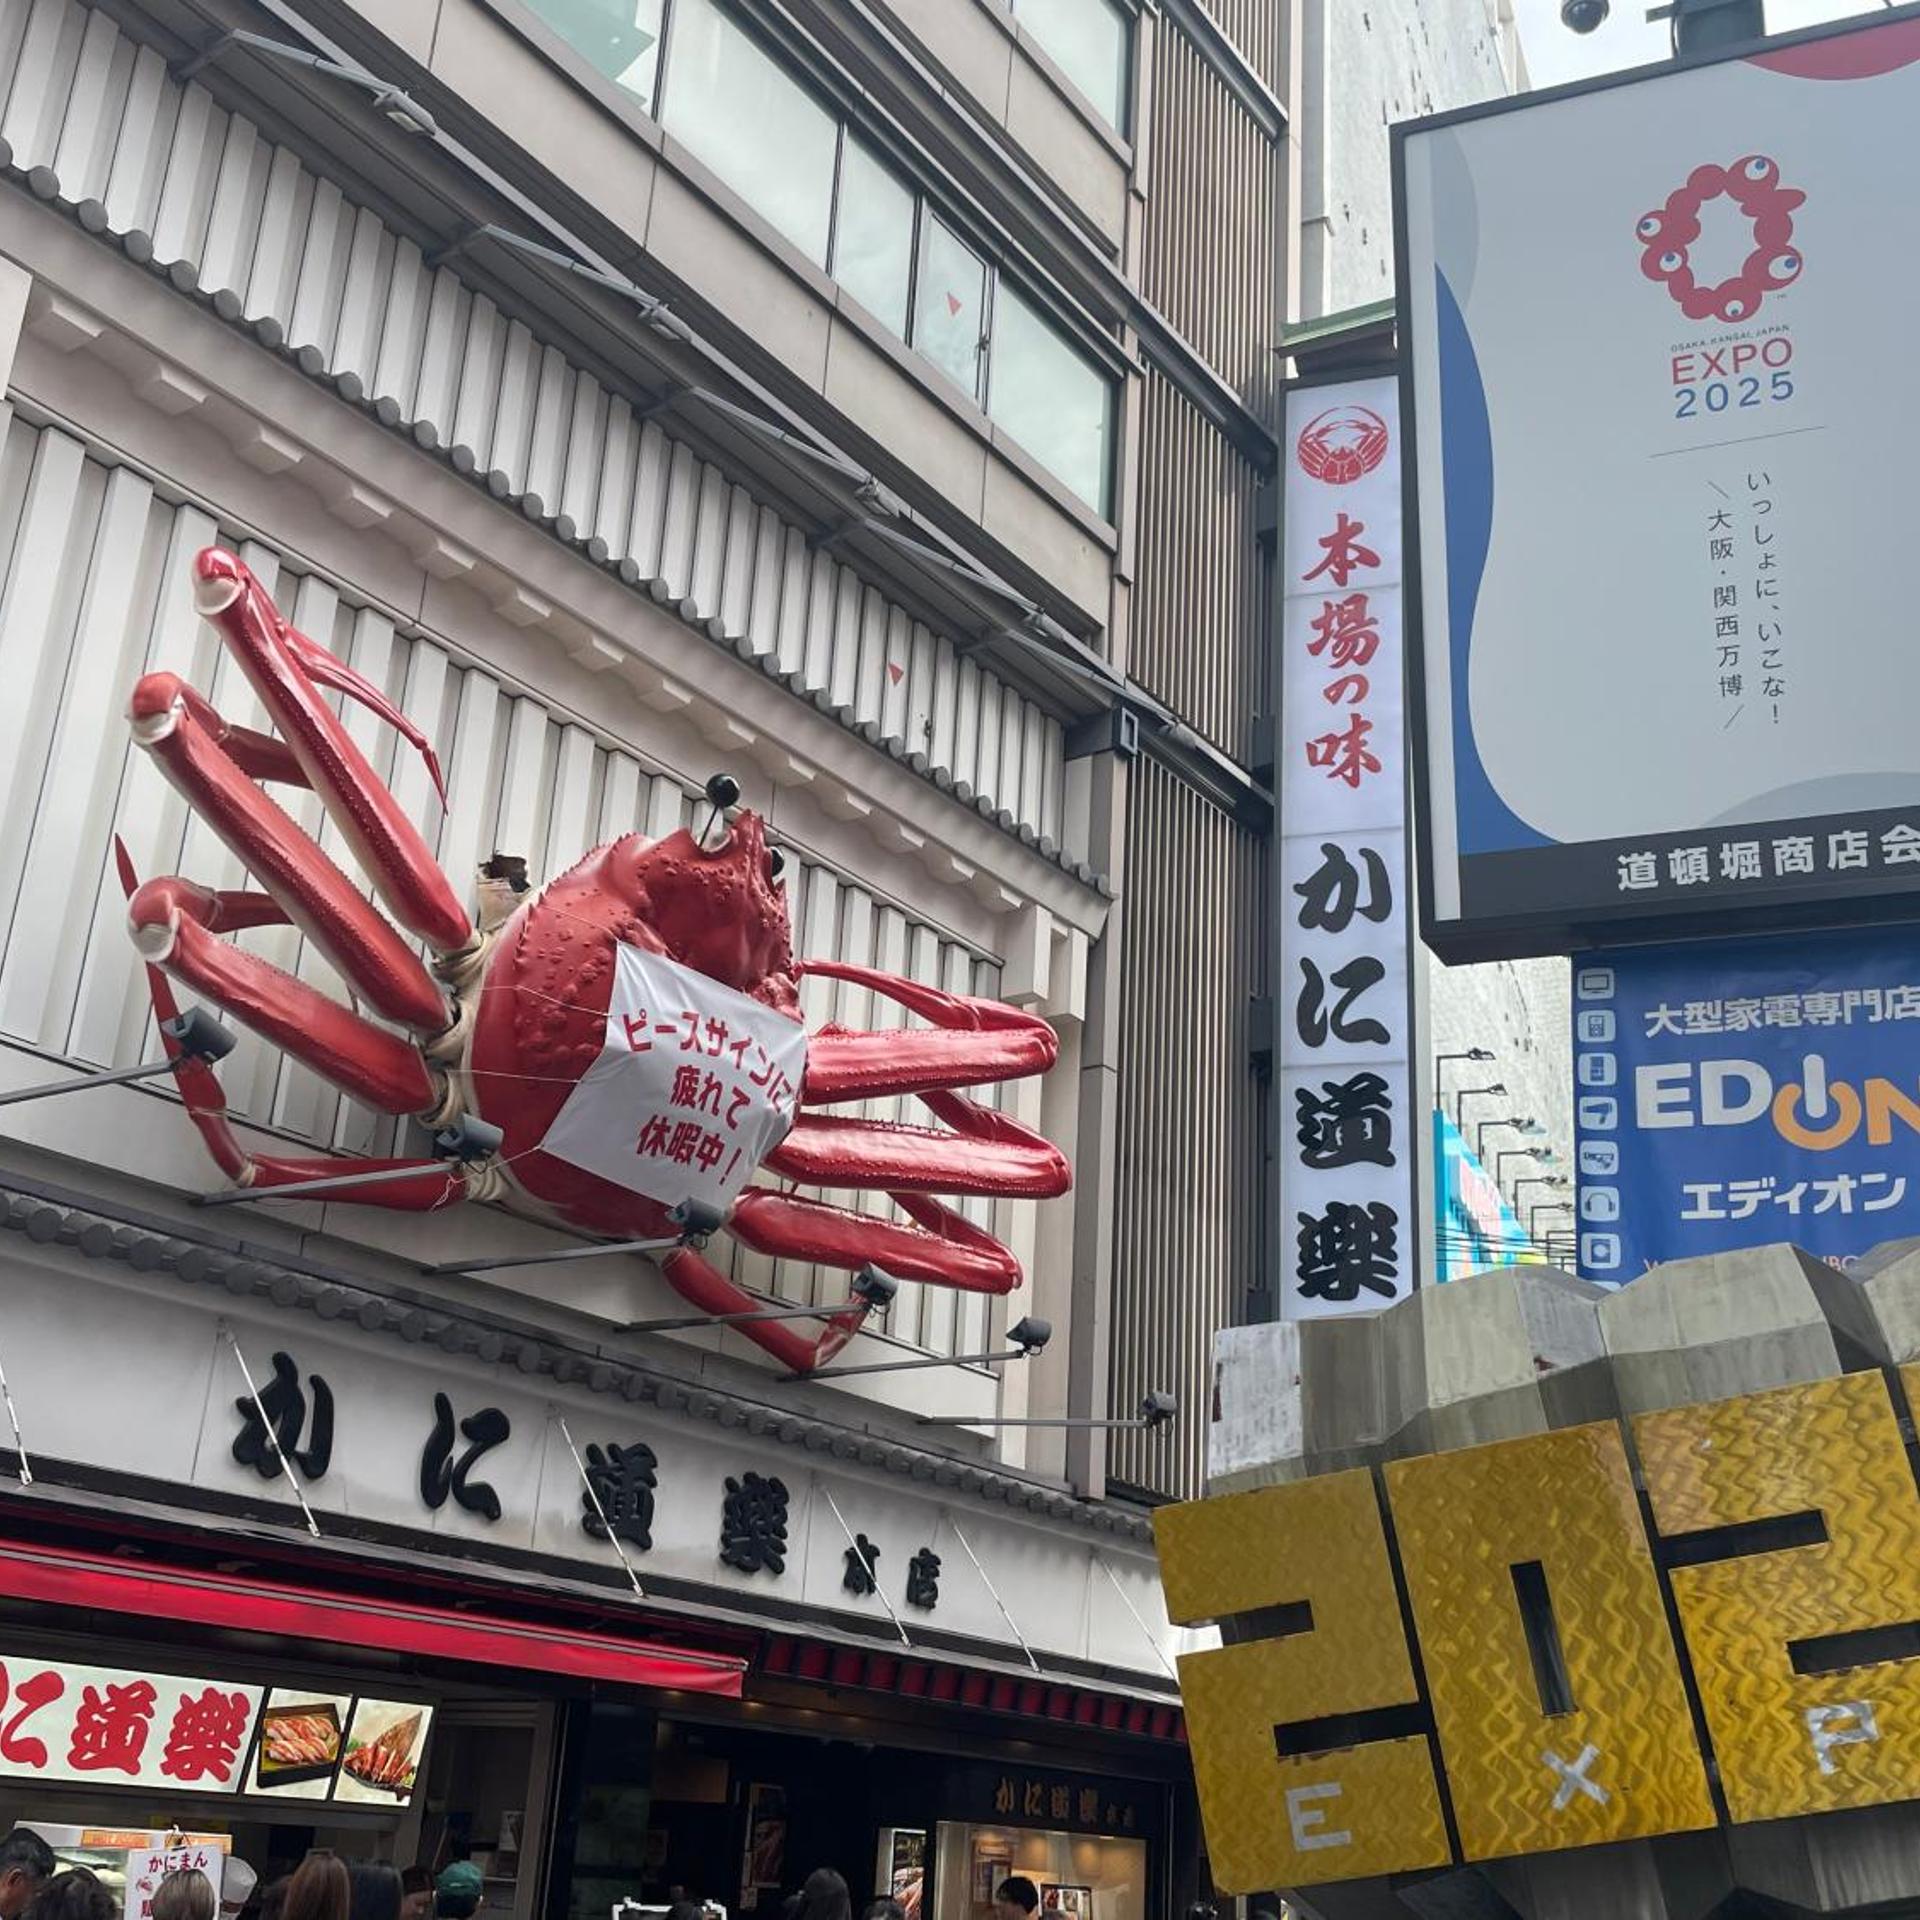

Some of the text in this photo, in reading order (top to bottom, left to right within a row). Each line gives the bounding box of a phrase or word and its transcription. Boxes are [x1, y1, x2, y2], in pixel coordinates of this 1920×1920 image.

[1756, 324, 1790, 338] JAPAN
[1671, 337, 1793, 385] EXPO
[1674, 371, 1794, 419] 2025
[1302, 513, 1382, 789] 本場の味
[1617, 824, 1920, 891] 道頓堀商店会
[1644, 985, 1920, 1039] 大型家電専門店
[622, 1008, 791, 1114] ピースサインに
[669, 1065, 750, 1130] 疲れて
[636, 1114, 742, 1185] 休暇中！
[1681, 1172, 1906, 1220] エディオン
[148, 1850, 208, 1874] かにまん
